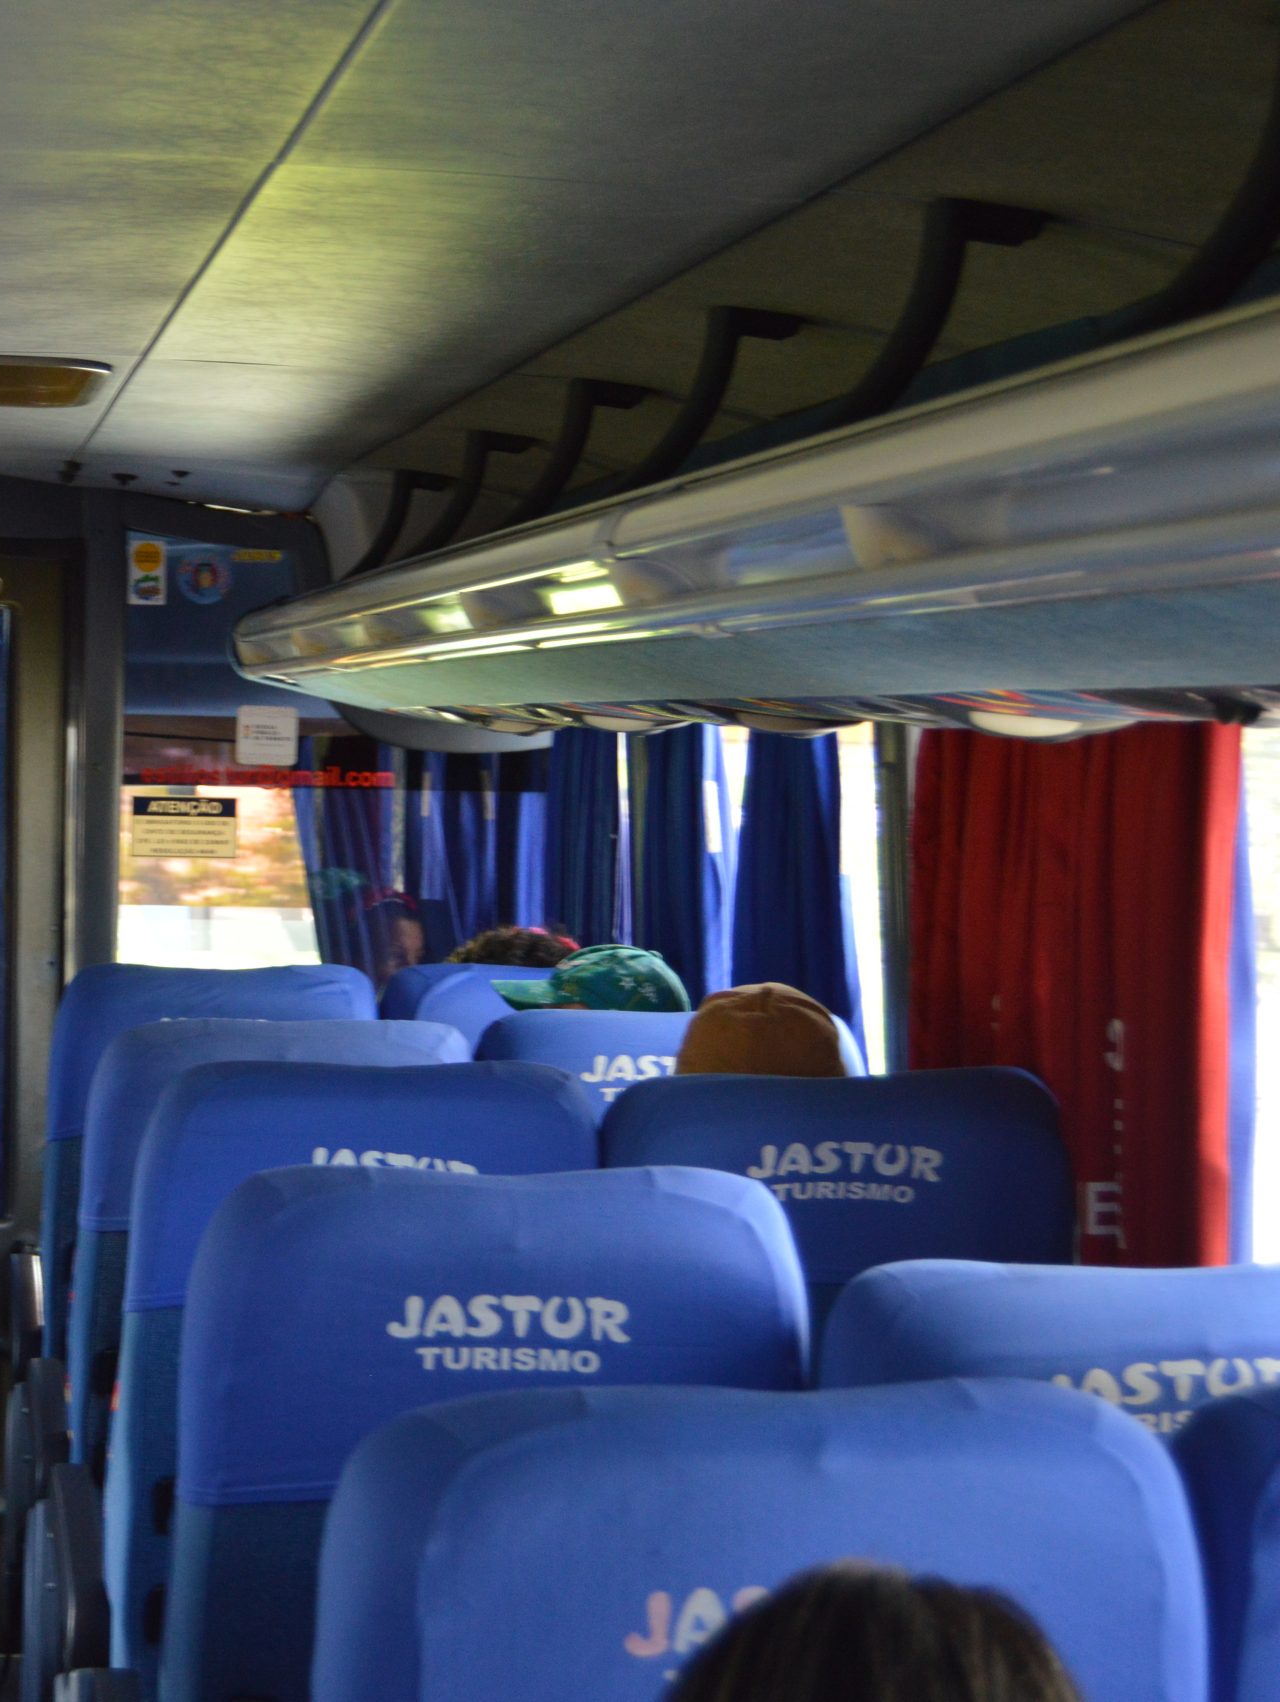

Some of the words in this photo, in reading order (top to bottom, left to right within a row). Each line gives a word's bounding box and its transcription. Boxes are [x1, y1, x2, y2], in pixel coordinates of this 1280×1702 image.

[146, 799, 223, 816] ATENÇÃO
[580, 1054, 677, 1082] JAST
[747, 1141, 943, 1182] JASTUR
[772, 1181, 915, 1203] TURISMO
[386, 1294, 631, 1343] JASTUR
[416, 1347, 601, 1373] TURISMO
